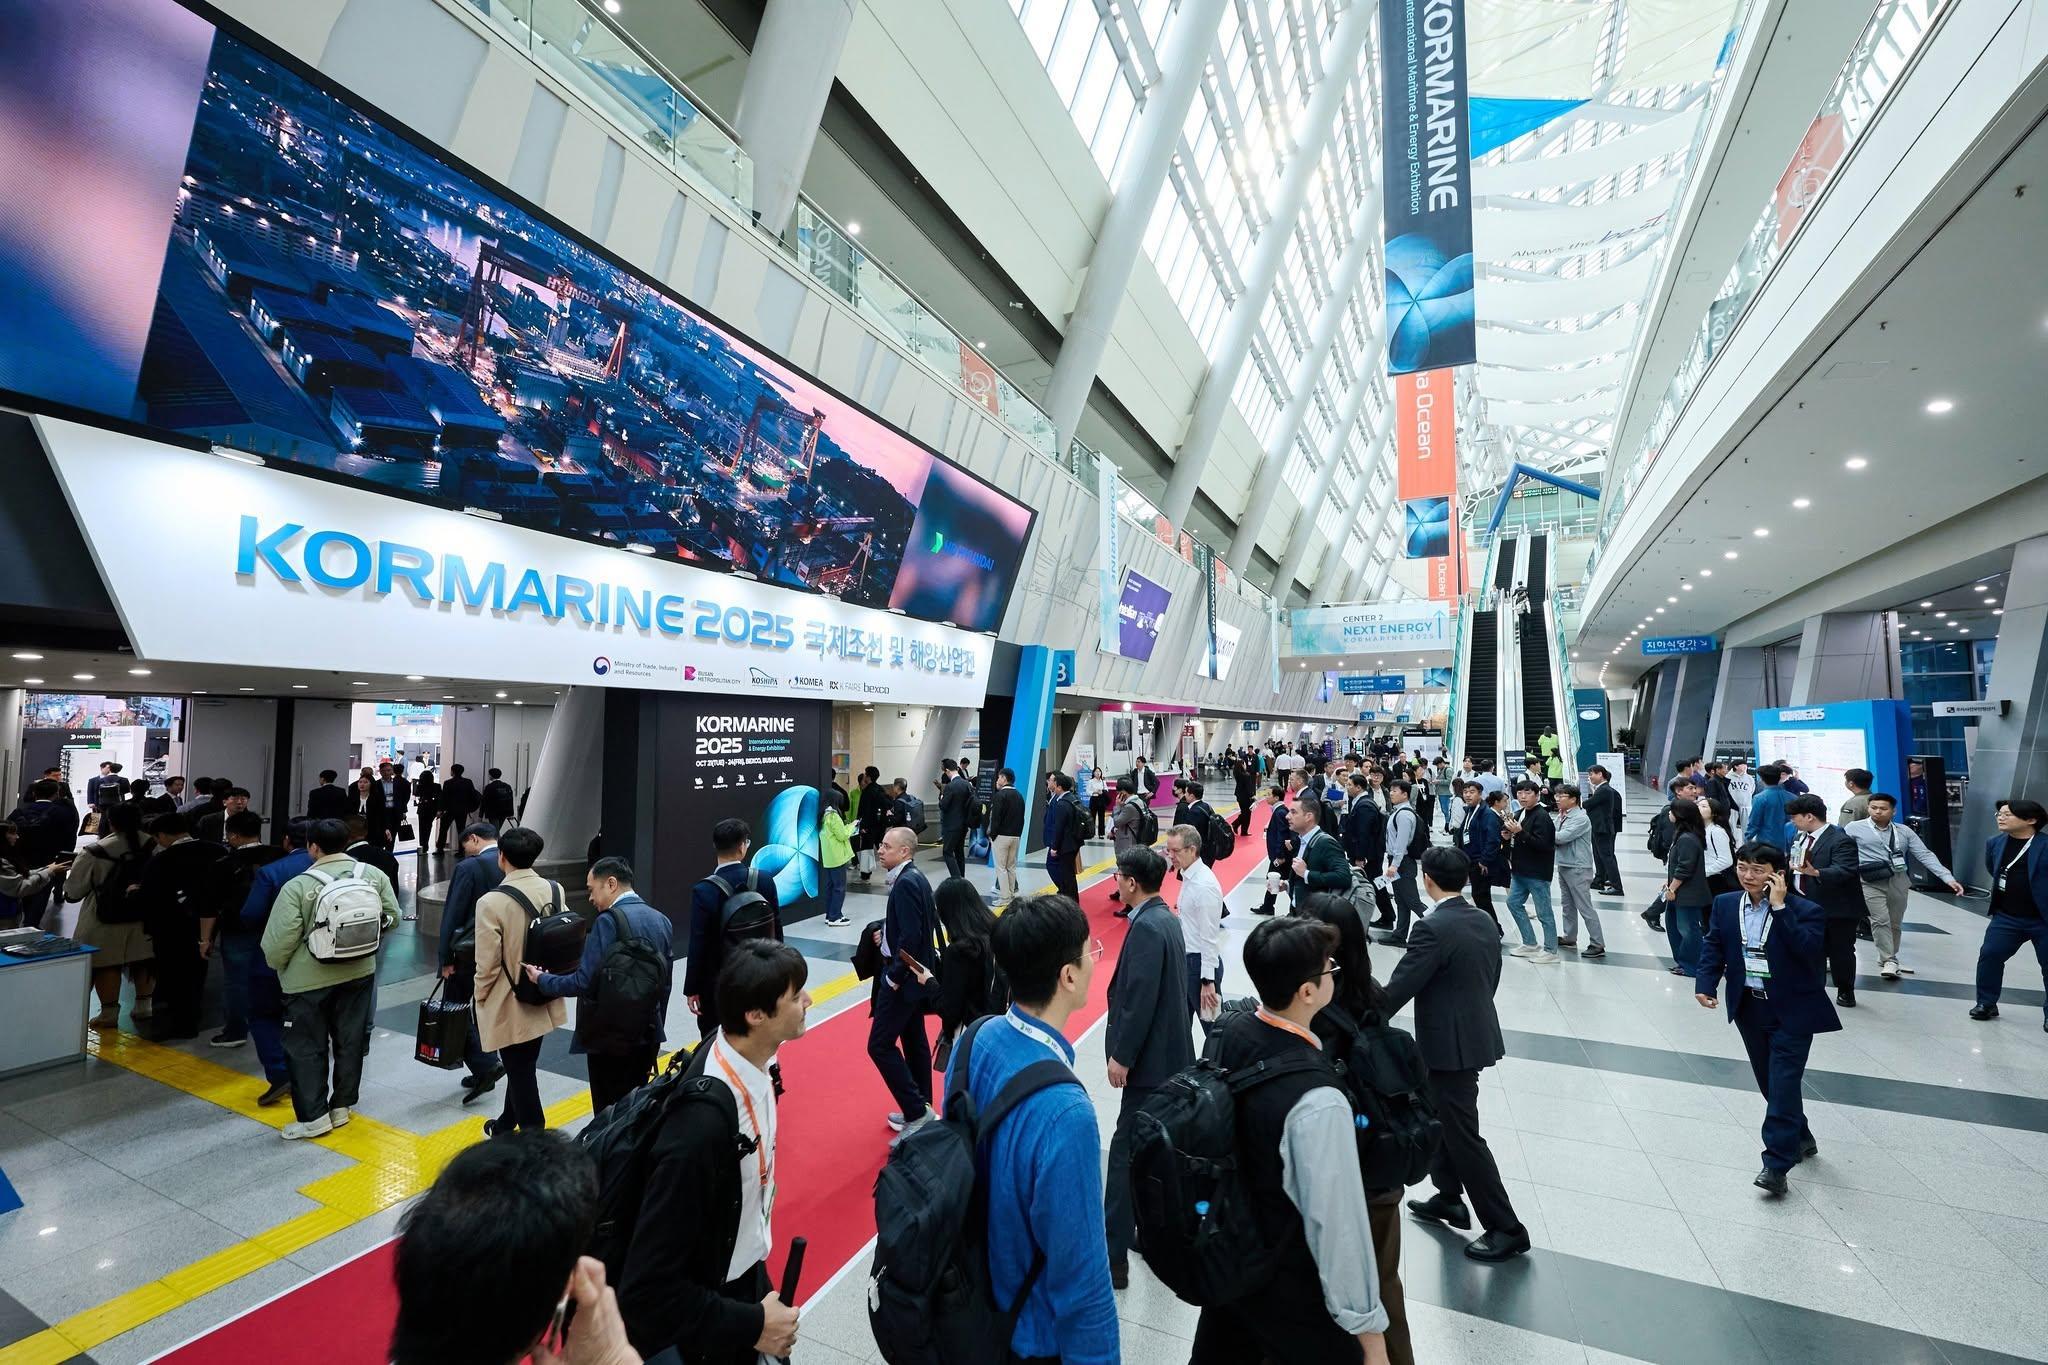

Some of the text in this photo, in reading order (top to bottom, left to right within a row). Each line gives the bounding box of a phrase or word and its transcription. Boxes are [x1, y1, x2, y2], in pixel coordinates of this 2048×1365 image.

[1406, 0, 1422, 215] nternational Maritime & Energy Exhibition
[1417, 393, 1434, 461] Ocean
[234, 514, 976, 675] KORMARINE 2025 국제조선 및 해양산업전
[1343, 615, 1377, 623] CENTER
[1344, 622, 1433, 636] NEXT ENERGY
[614, 661, 635, 669] Ministry
[659, 664, 678, 672] Industry
[625, 669, 652, 677] Resources
[799, 677, 824, 687] KOMEA
[829, 680, 839, 690] RX
[863, 682, 890, 695] bexco
[696, 716, 795, 733] KORMARINE
[695, 737, 742, 755] 2025
[1730, 781, 1748, 791] NYC
